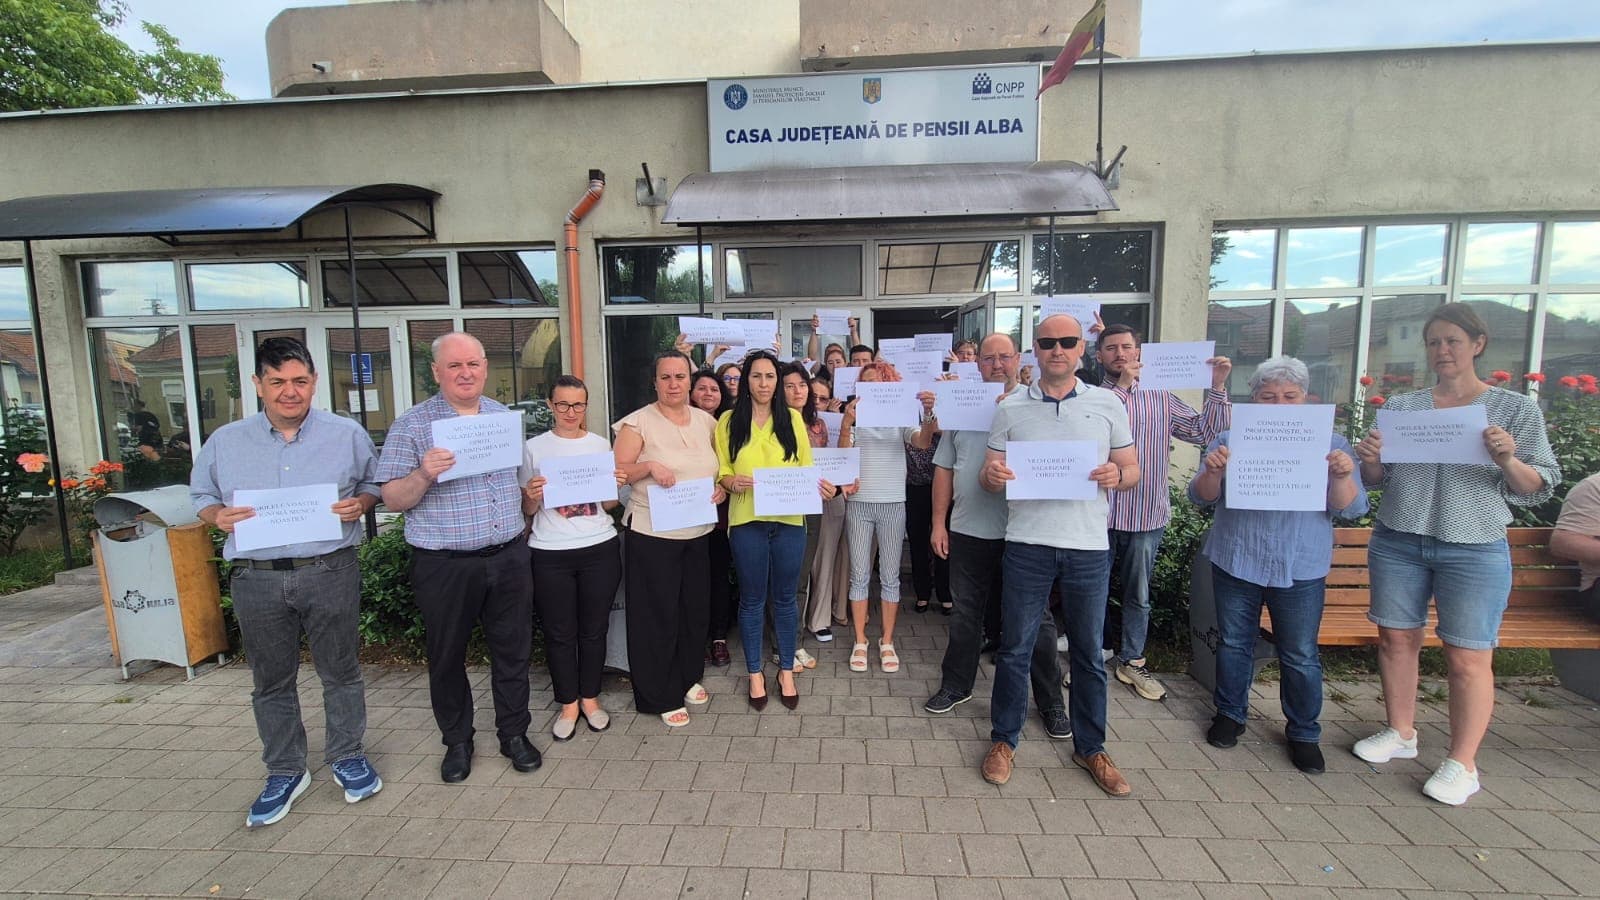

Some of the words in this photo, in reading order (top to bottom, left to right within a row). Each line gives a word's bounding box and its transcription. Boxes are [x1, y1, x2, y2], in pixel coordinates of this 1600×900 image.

[995, 81, 1025, 94] CNPP
[725, 128, 773, 144] CASA
[777, 120, 881, 145] JUDEȚEANĂ
[885, 123, 908, 138] DE
[912, 120, 970, 138] PENSII
[974, 118, 1024, 135] ALBA
